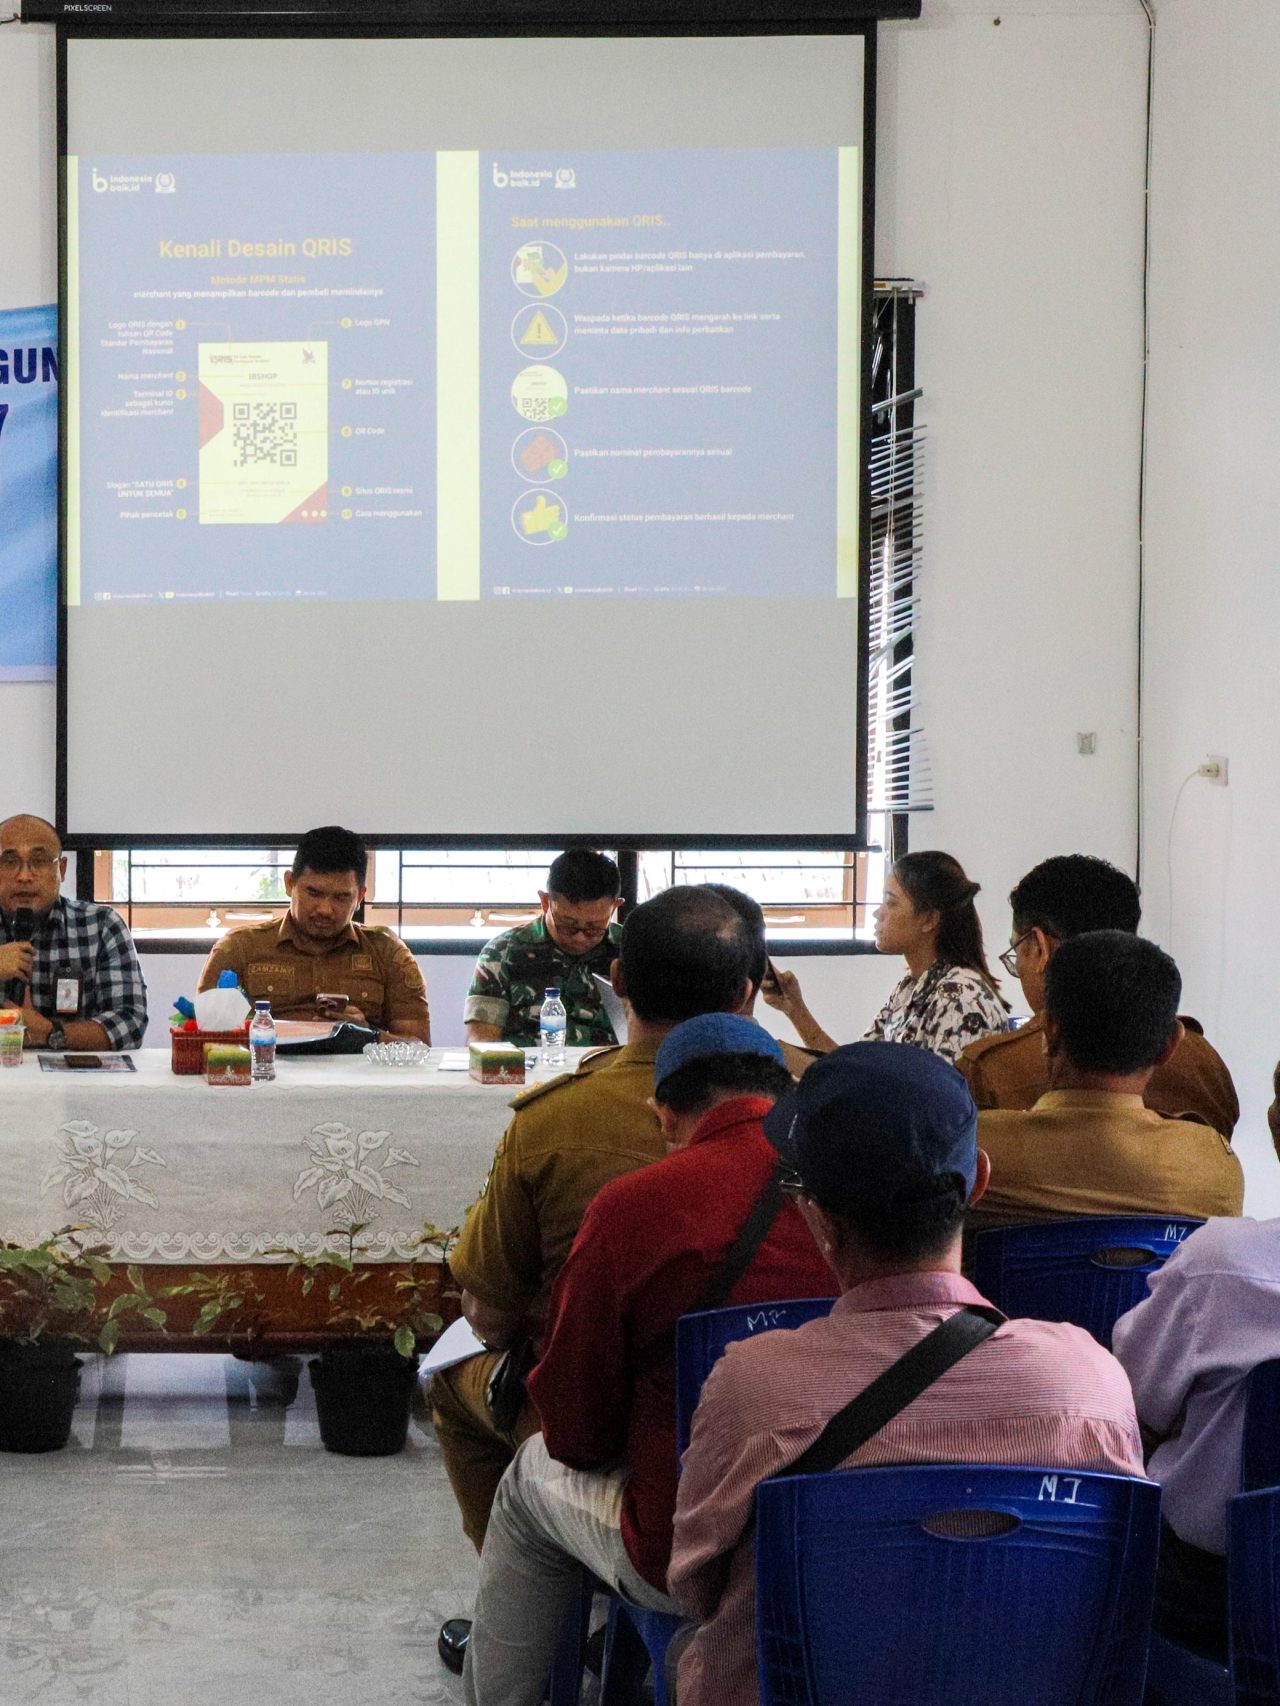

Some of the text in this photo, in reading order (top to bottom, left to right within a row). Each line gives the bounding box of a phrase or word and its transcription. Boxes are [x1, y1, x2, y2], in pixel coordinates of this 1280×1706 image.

[63, 4, 112, 12] PIXELSCREEN
[511, 216, 539, 228] Saat
[542, 215, 629, 230] menggunakan
[159, 237, 353, 259] Kenali Desain QRIS
[172, 290, 192, 300] yang
